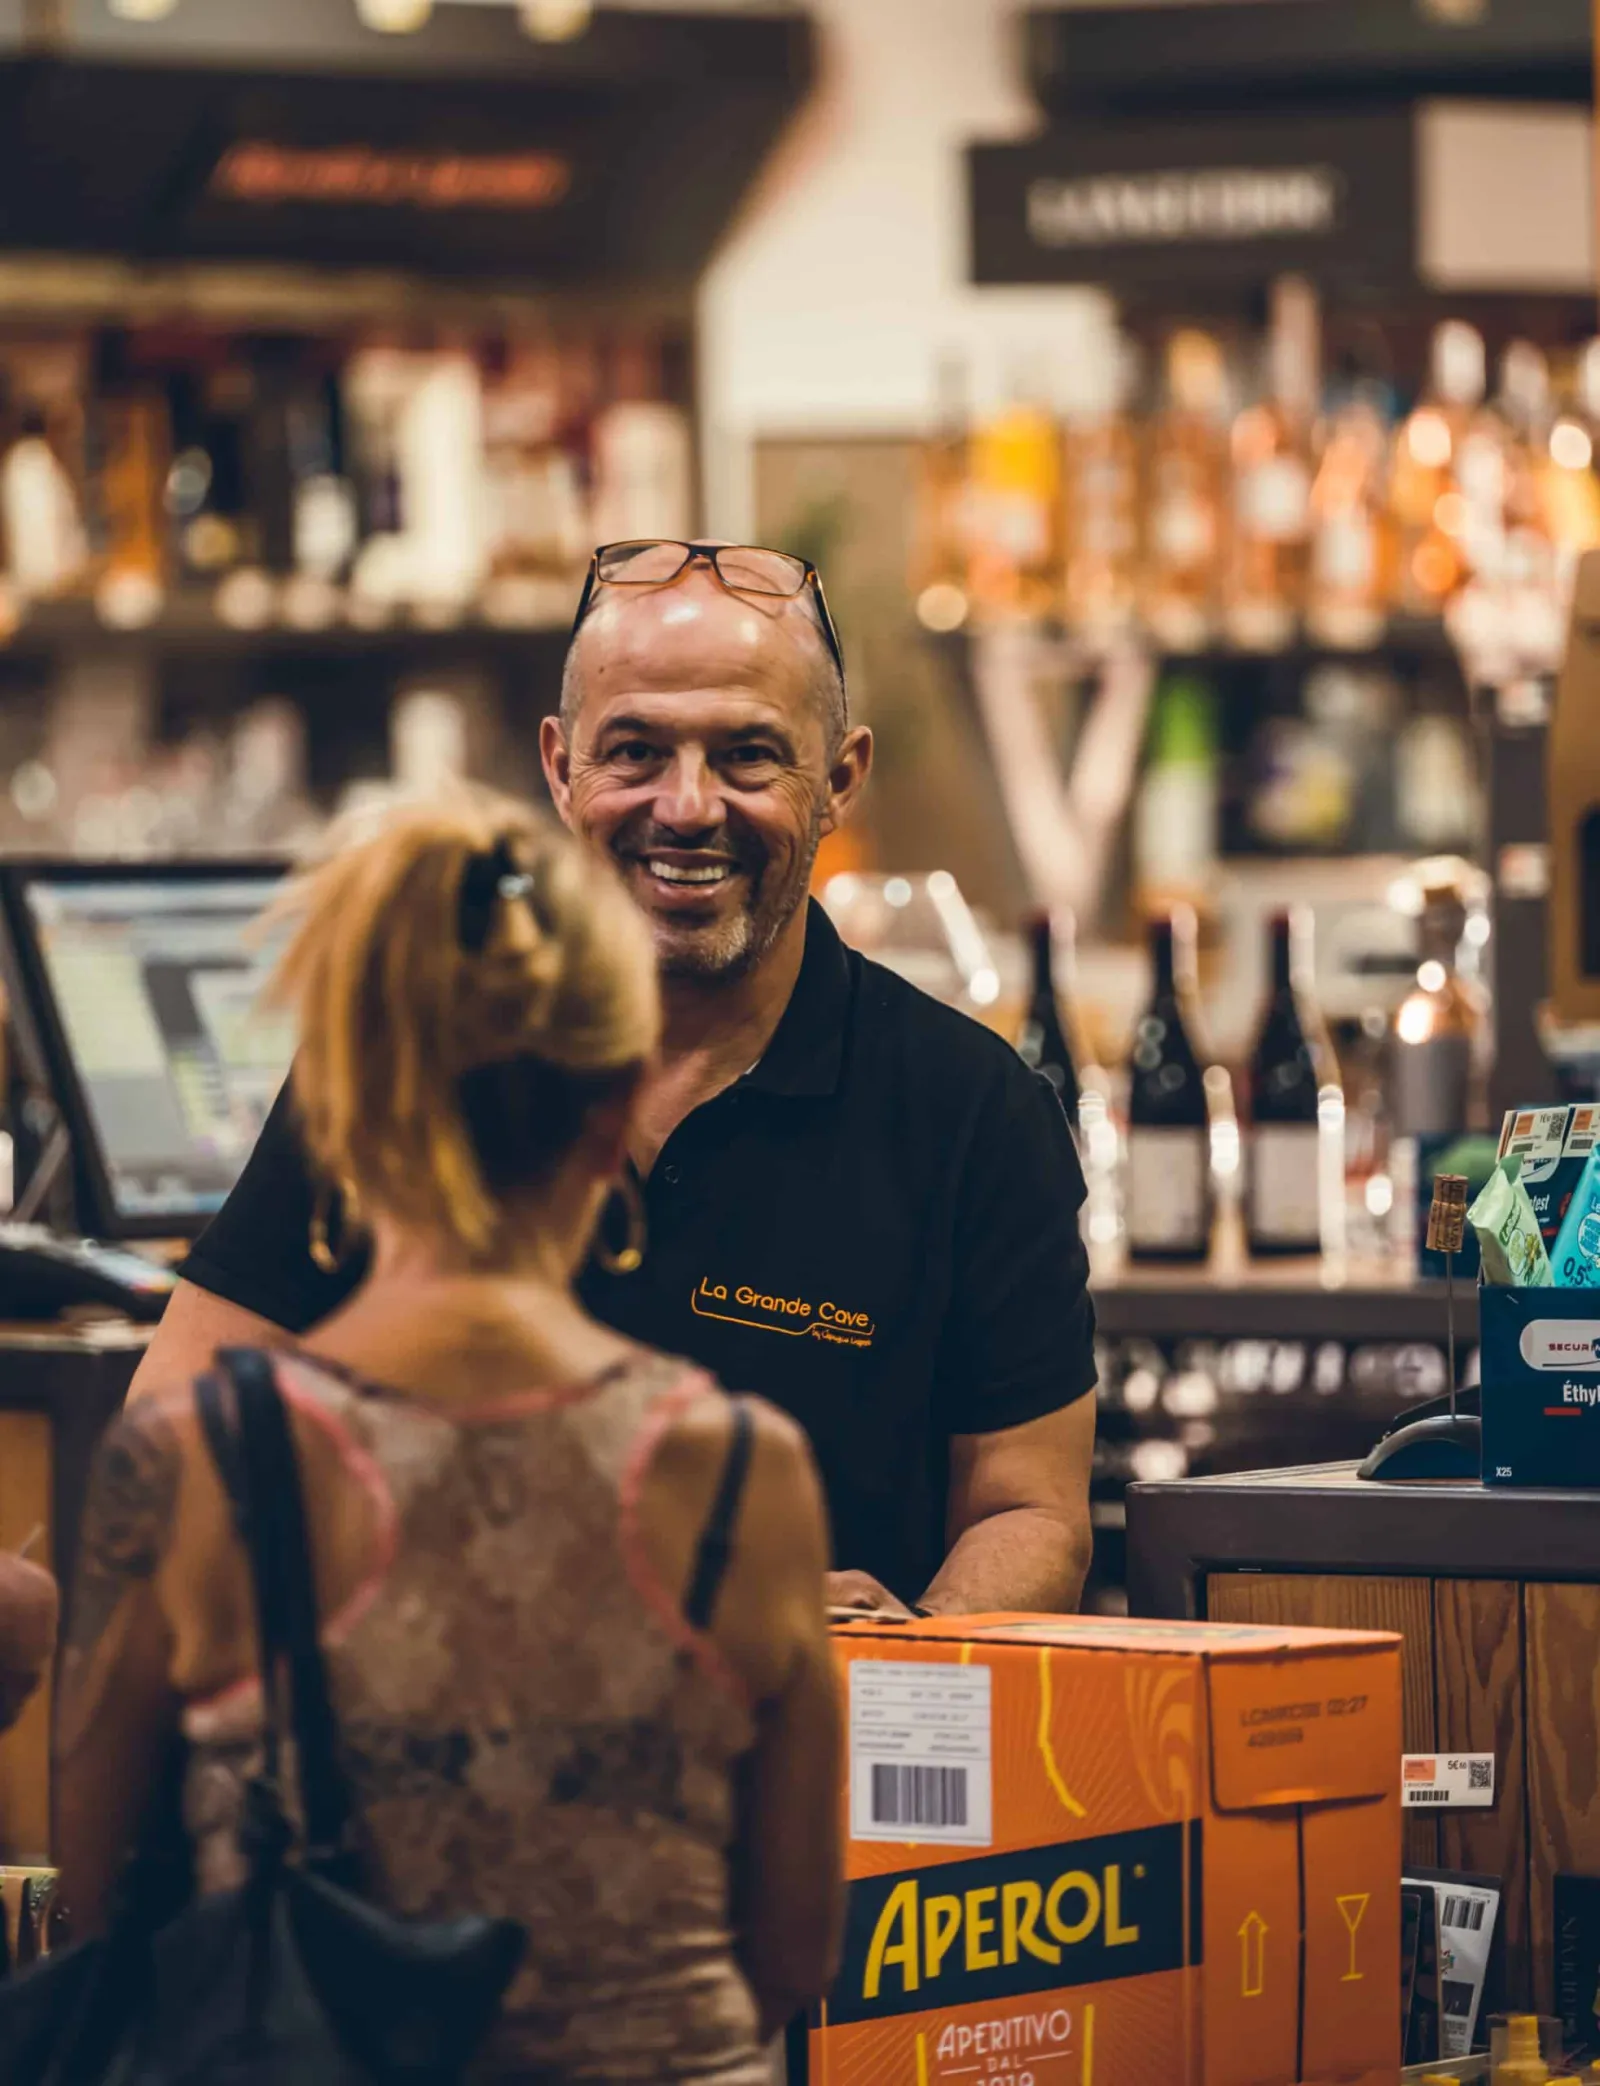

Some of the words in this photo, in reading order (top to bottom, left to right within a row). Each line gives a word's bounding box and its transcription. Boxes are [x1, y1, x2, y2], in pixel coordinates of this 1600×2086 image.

[1529, 1194, 1550, 1211] test
[700, 1276, 728, 1300] La
[735, 1286, 811, 1316] Grande
[818, 1302, 869, 1326] Cave
[862, 1864, 1140, 1999] APEROL
[936, 2009, 1071, 2060] APERITIVO
[986, 2054, 1024, 2074] DAL
